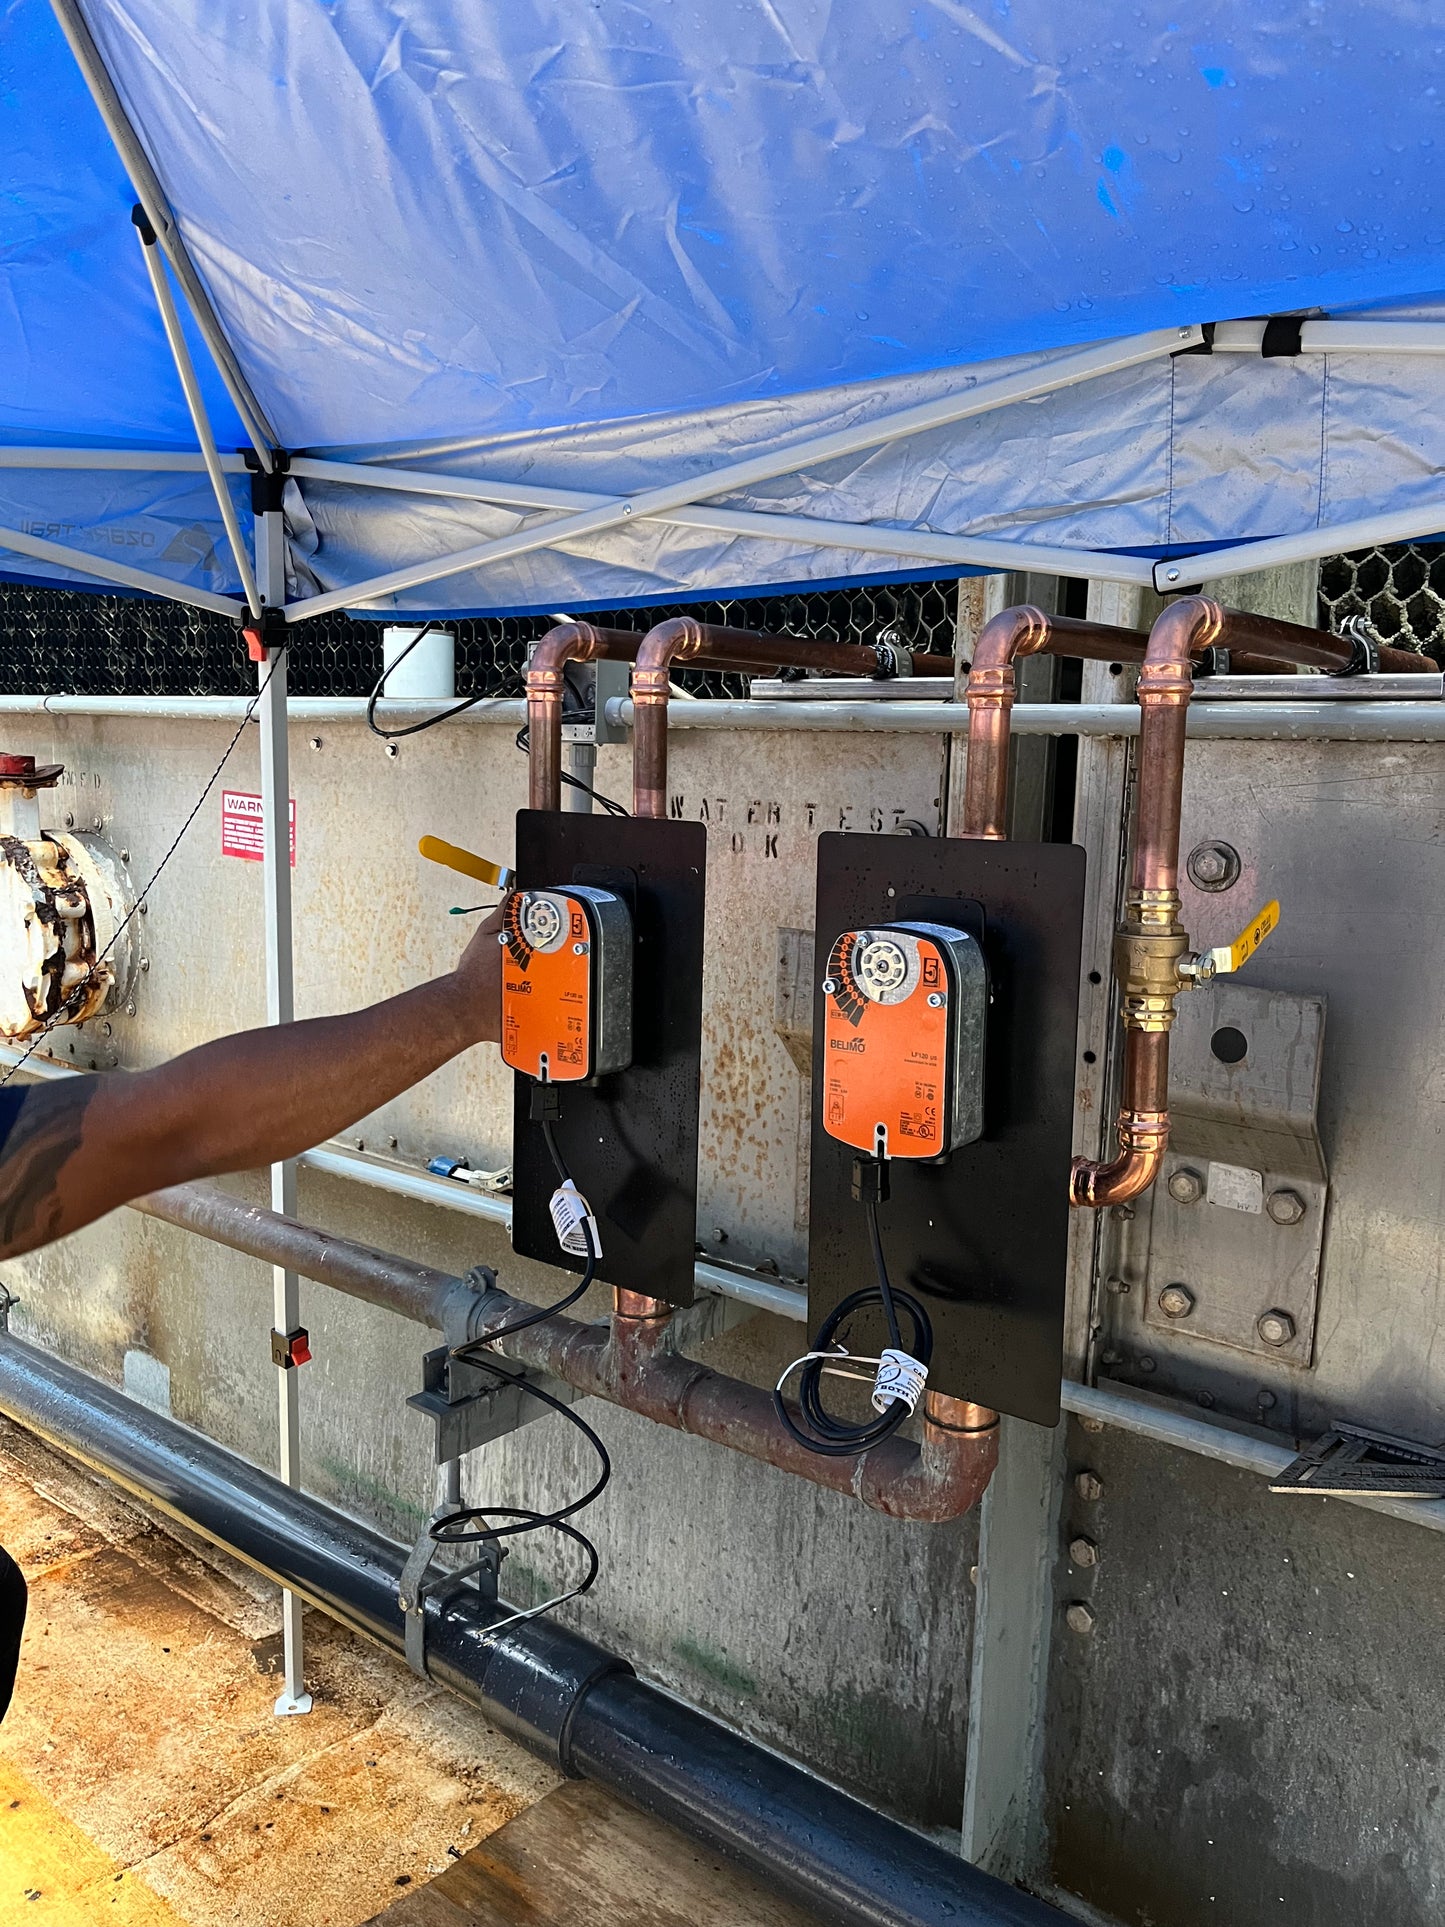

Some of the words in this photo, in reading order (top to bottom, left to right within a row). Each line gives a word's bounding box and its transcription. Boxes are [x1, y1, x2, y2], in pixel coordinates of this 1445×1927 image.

[227, 798, 264, 813] WARN
[506, 982, 532, 994] BELIMO
[830, 1039, 866, 1053] BELIMO
[881, 1385, 909, 1397] BOTH
